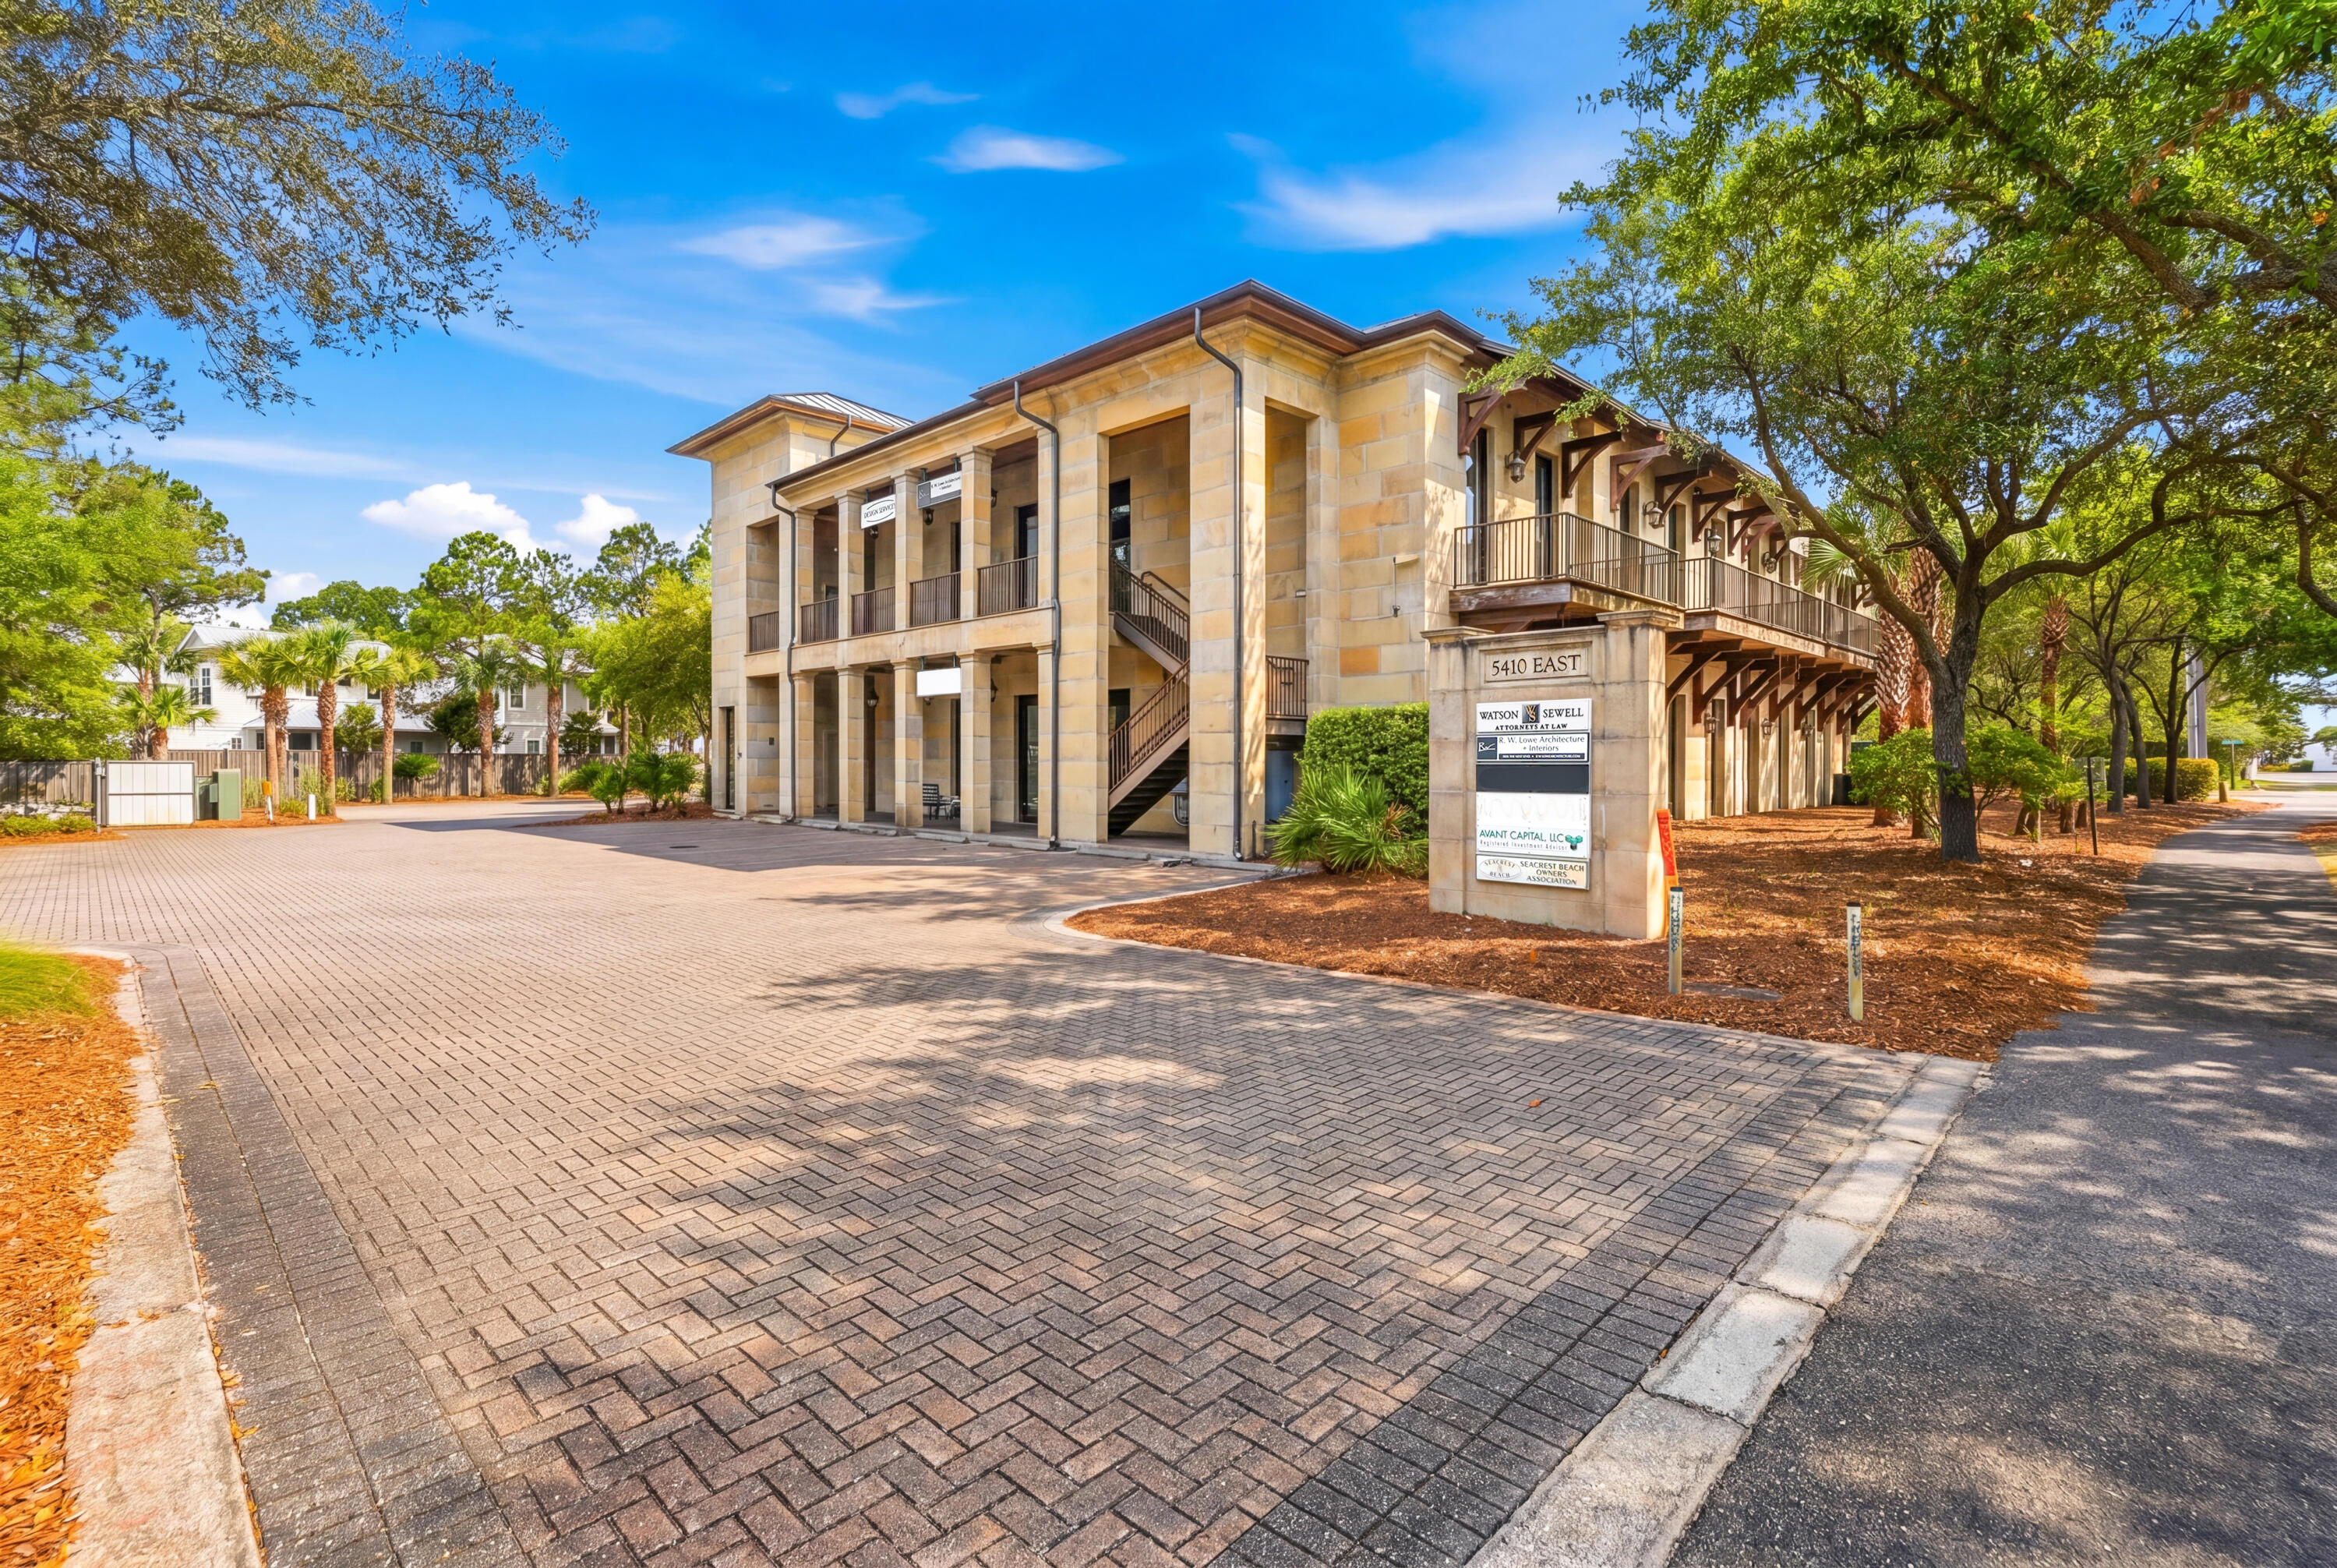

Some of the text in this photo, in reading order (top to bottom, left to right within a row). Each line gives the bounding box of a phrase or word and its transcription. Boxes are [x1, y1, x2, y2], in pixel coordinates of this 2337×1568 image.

[864, 509, 878, 518] DESIGN
[1492, 655, 1581, 676] 5410 EAST
[1480, 708, 1583, 720] WATSON SEWELL
[1480, 829, 1564, 842] AVANT CAPITAL, LLC
[1484, 859, 1515, 868] SEACREST
[1520, 860, 1584, 872] SEACREST BEACH
[1536, 869, 1567, 878] OWNERS
[1527, 876, 1577, 885] ASSOCIATION
